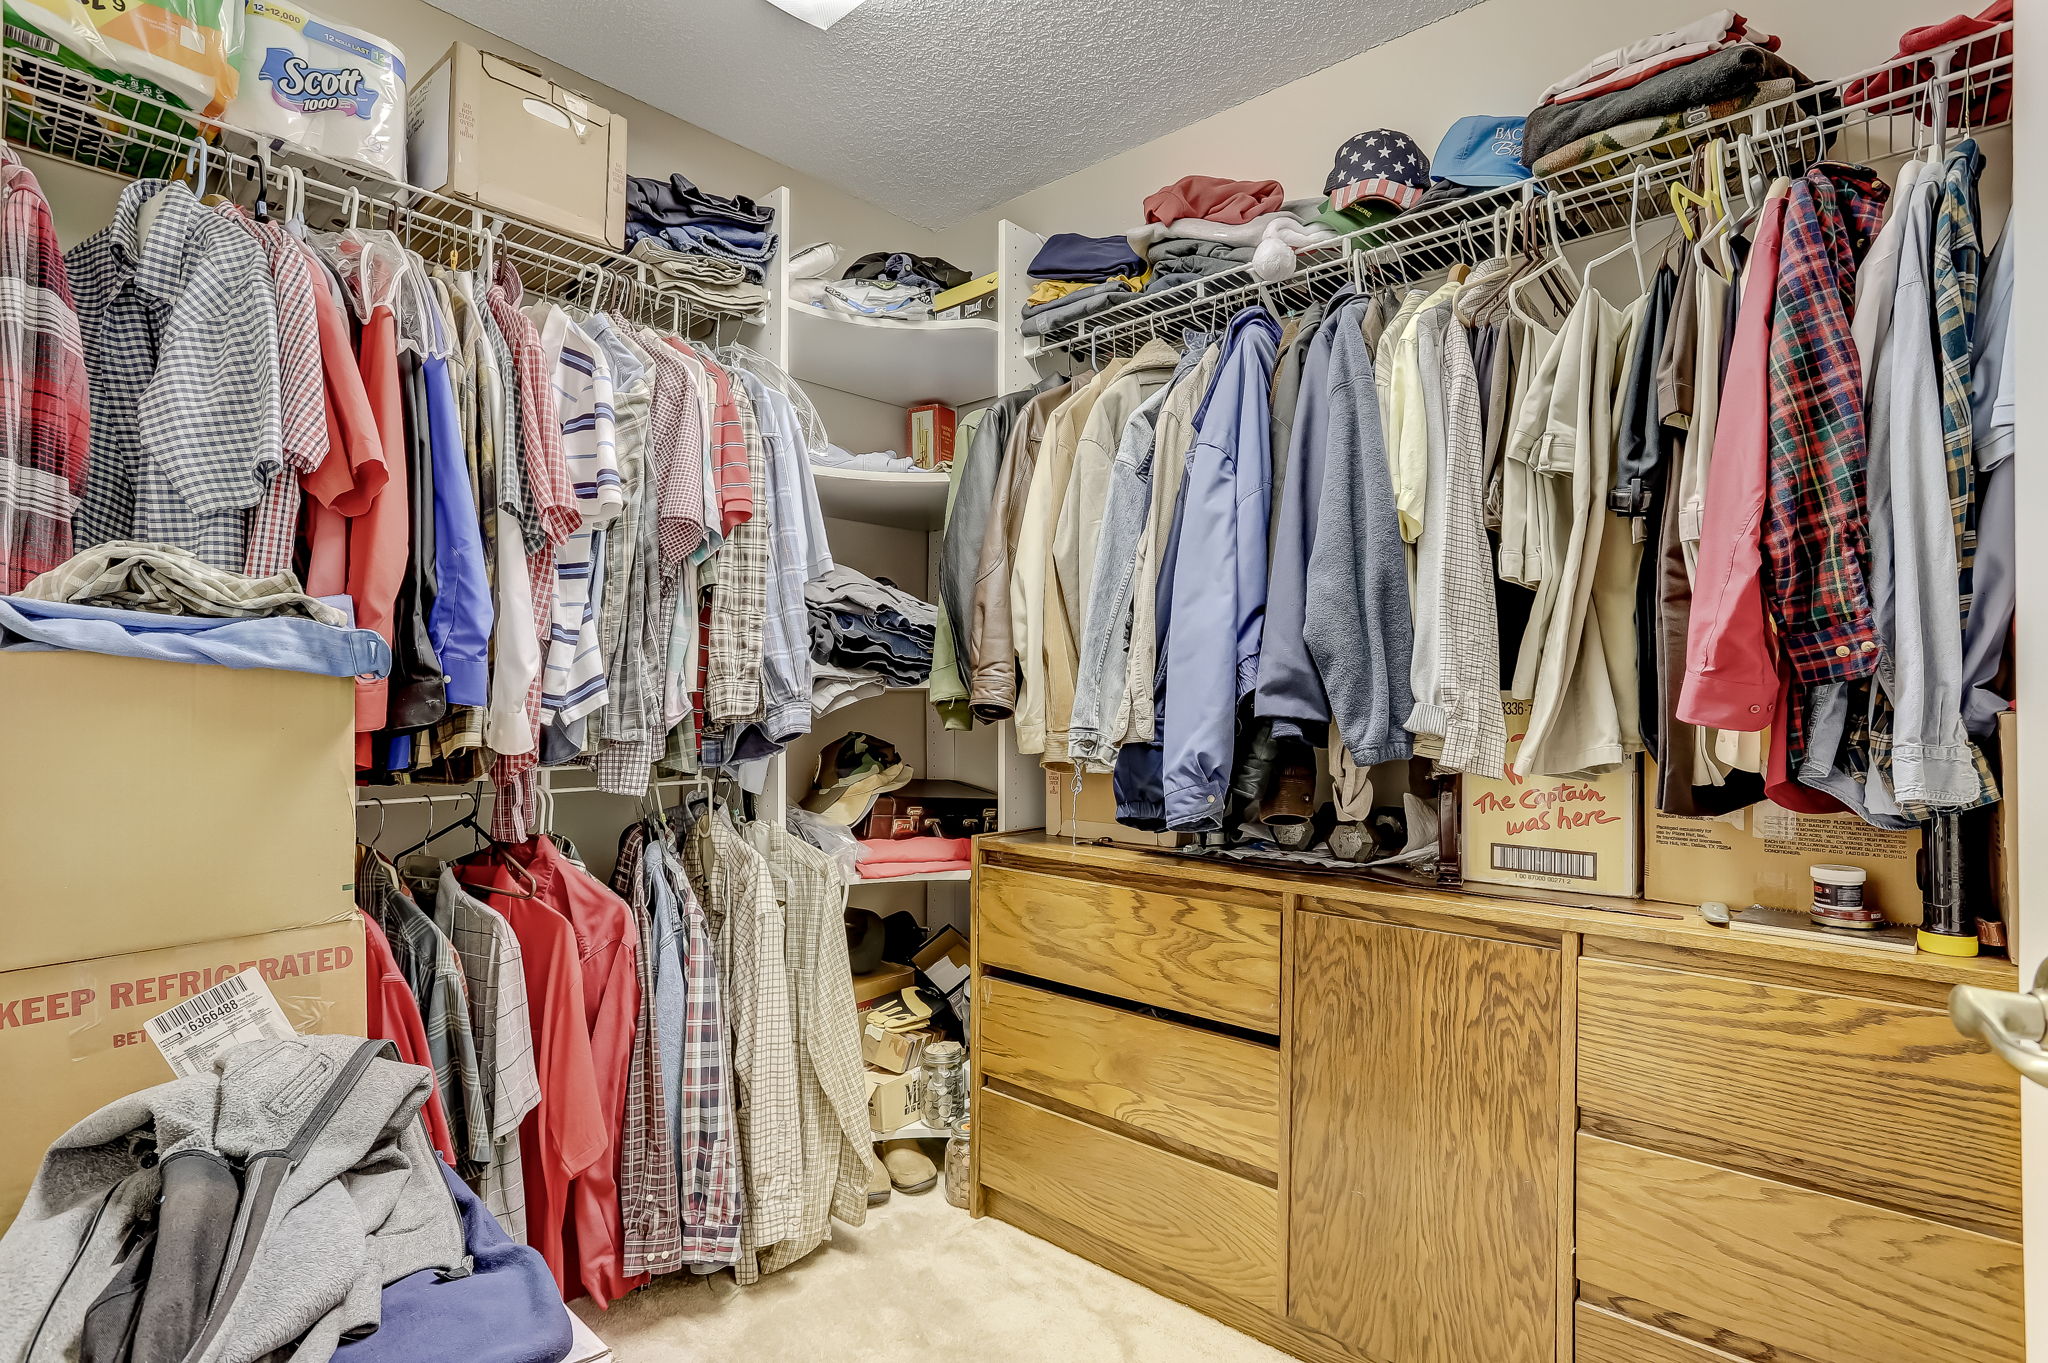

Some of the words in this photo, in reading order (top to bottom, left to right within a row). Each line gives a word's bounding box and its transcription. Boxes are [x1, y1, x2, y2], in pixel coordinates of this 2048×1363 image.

[352, 44, 369, 55] LAST
[278, 57, 363, 97] Scott
[303, 97, 339, 112] 1000
[1473, 792, 1515, 814] The
[1519, 783, 1606, 809] Captain
[1506, 811, 1550, 835] was
[1557, 806, 1621, 829] here
[0, 988, 96, 1030] KEEP
[182, 999, 239, 1034] 16366488
